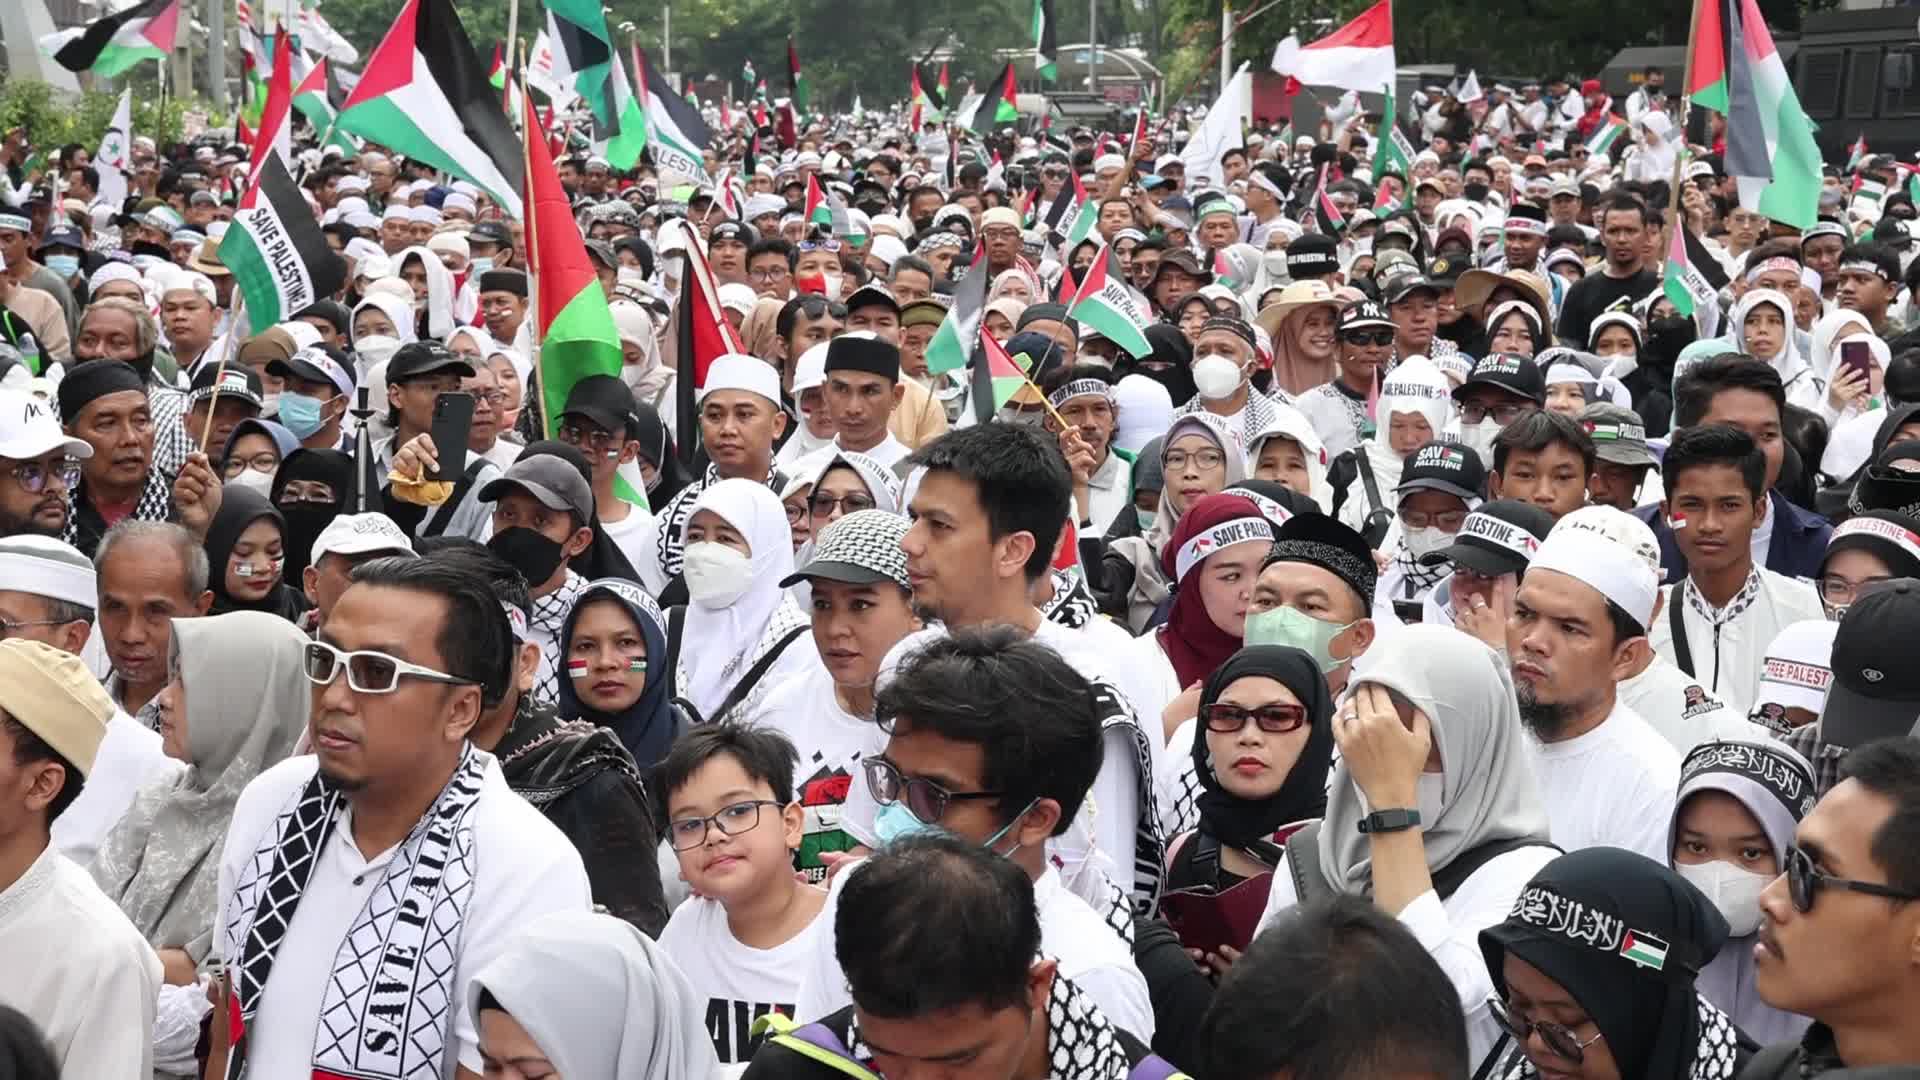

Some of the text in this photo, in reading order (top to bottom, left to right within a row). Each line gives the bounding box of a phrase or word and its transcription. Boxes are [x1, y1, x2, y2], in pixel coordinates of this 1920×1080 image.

[248, 207, 280, 245] SAVE
[1101, 283, 1127, 305] SAVE
[1393, 383, 1434, 399] PALESTINE
[1414, 459, 1462, 471] PALESTINE
[1213, 524, 1245, 547] SAVE
[1767, 660, 1786, 678] FREE
[363, 944, 417, 1058] SAVE
